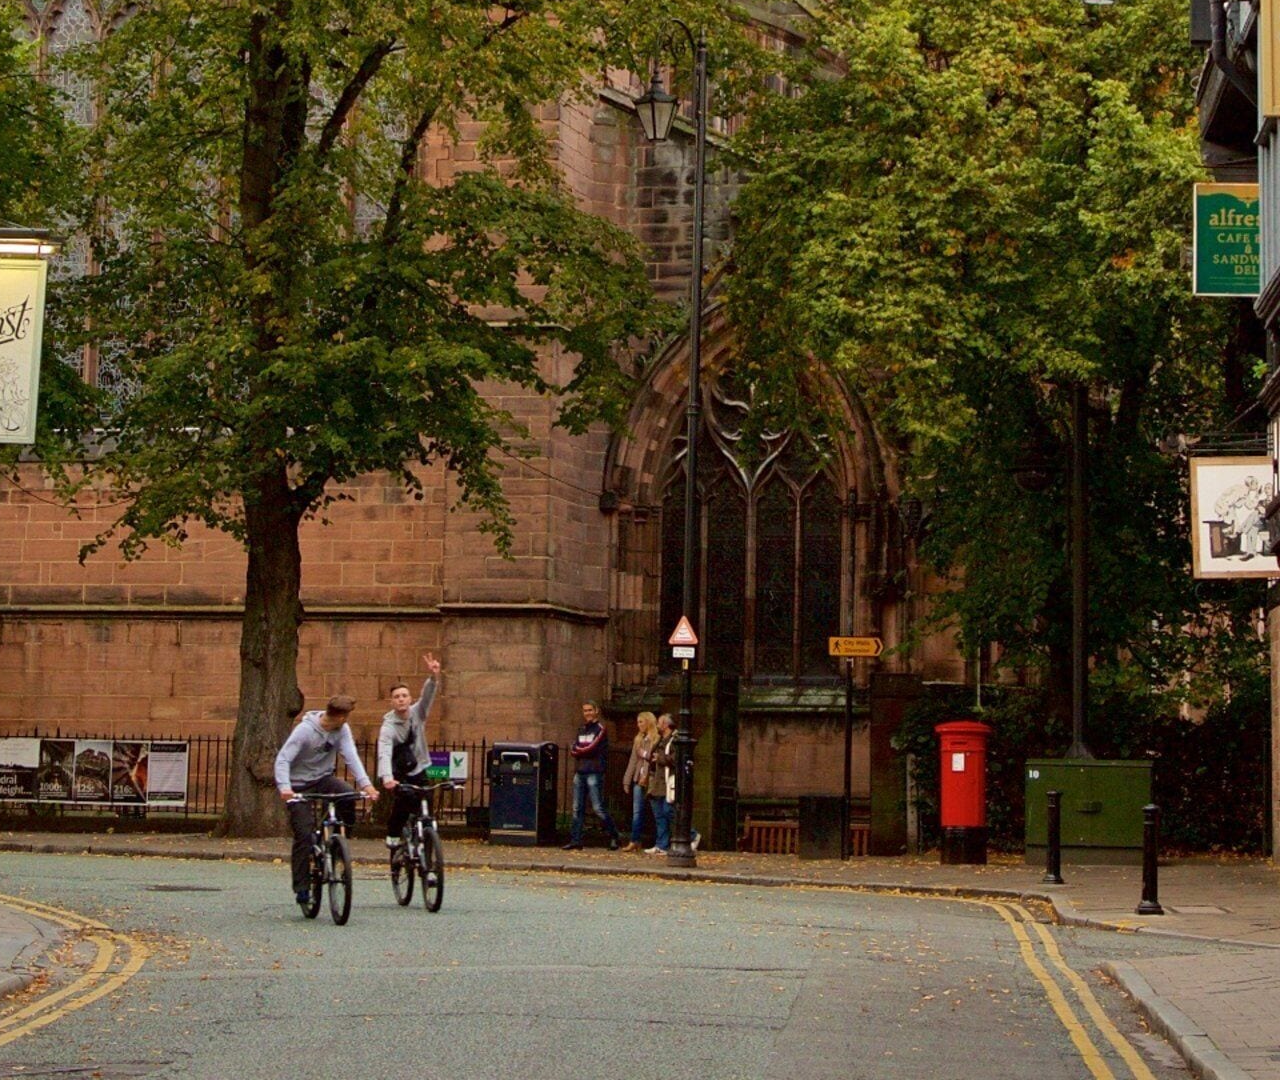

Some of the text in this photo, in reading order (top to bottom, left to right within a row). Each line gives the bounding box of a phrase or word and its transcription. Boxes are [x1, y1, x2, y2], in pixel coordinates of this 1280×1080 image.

[1216, 233, 1250, 243] CAFE
[1212, 254, 1261, 264] SANDW
[1234, 265, 1259, 275] DEL
[1028, 769, 1040, 779] 10
